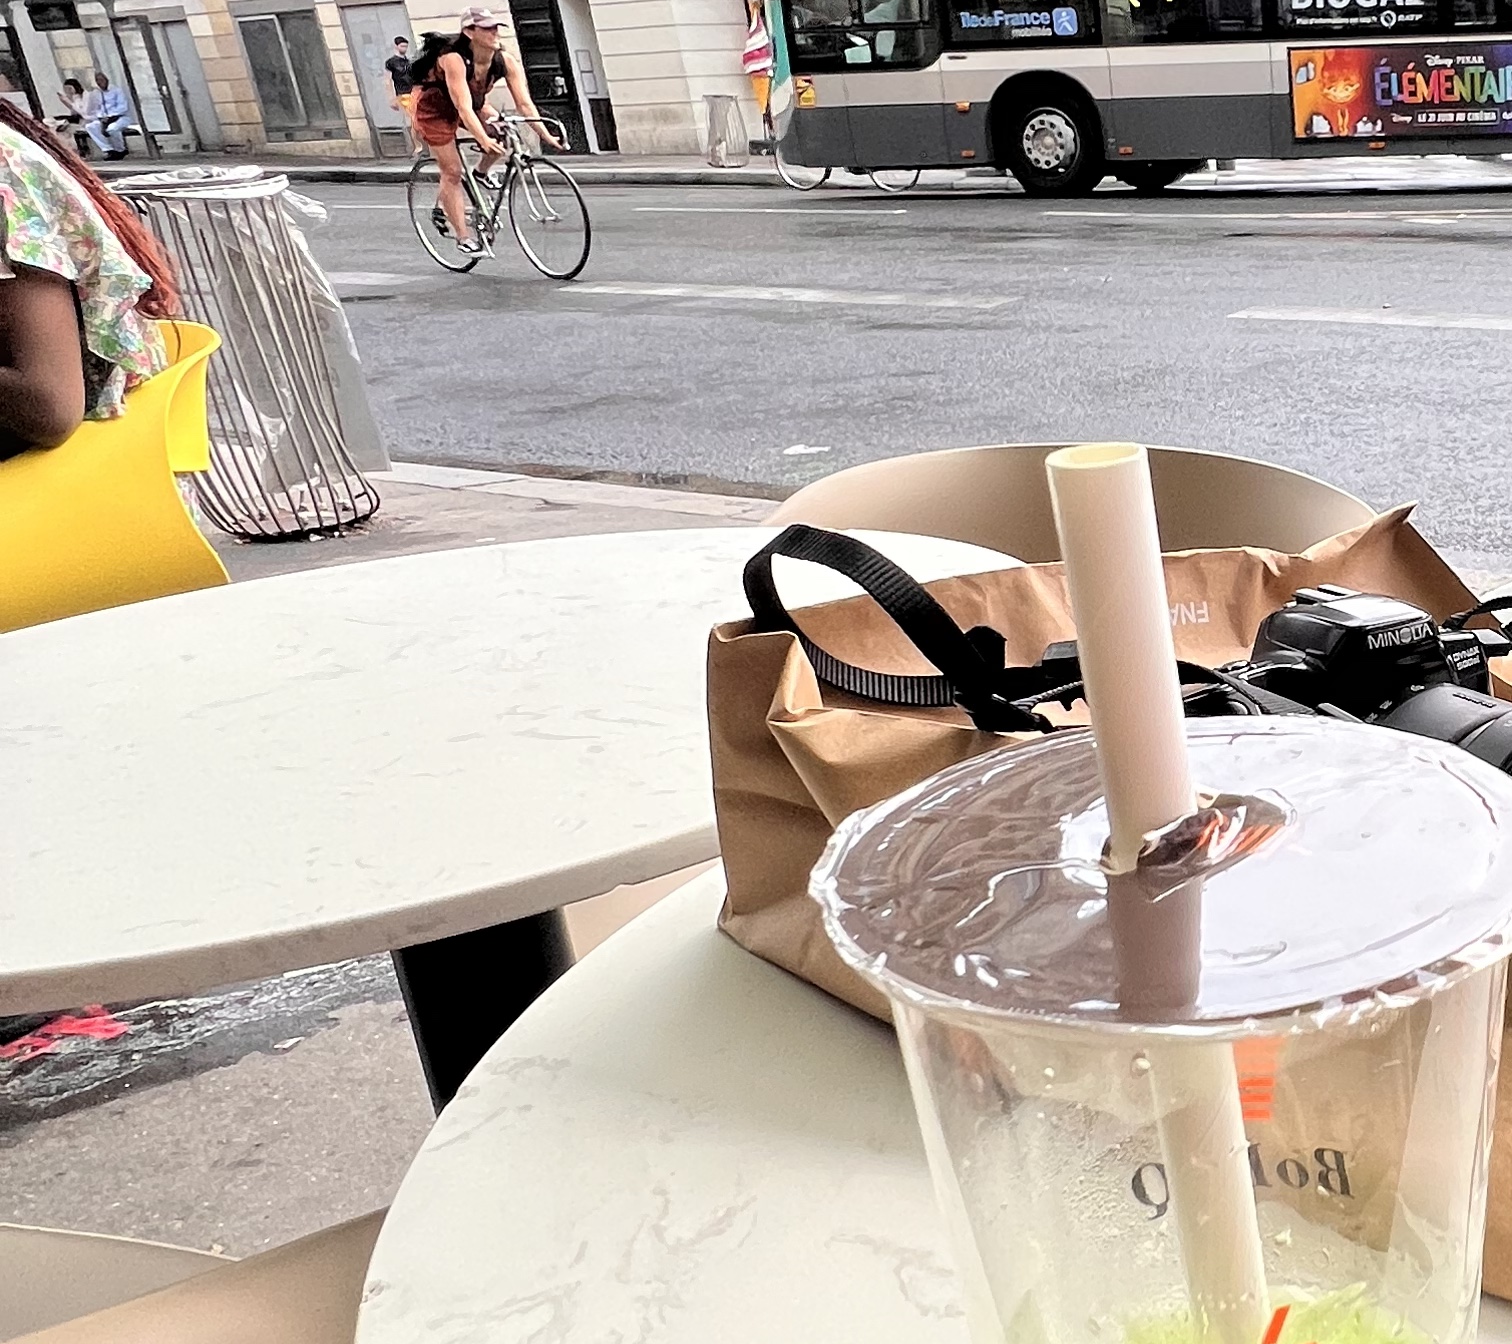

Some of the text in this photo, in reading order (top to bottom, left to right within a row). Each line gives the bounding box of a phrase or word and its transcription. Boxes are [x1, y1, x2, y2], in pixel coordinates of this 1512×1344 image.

[1424, 54, 1485, 67] Disney PIXAR
[1367, 623, 1434, 650] MINOLTA
